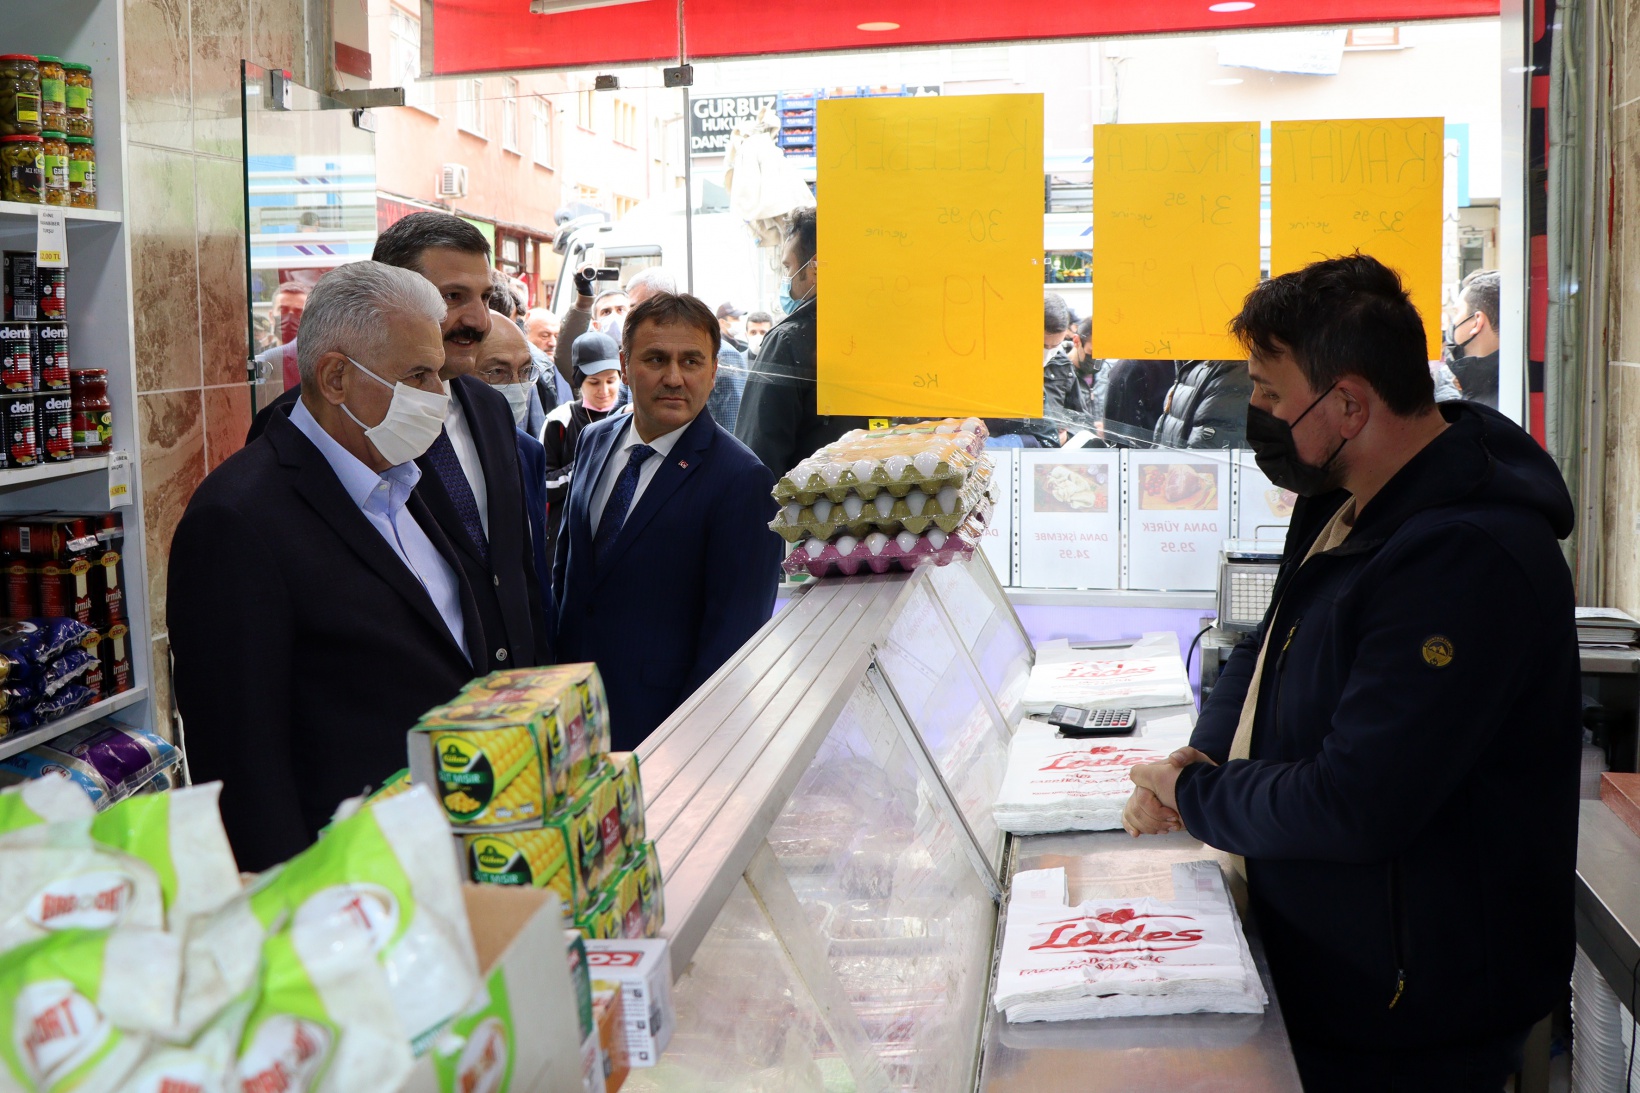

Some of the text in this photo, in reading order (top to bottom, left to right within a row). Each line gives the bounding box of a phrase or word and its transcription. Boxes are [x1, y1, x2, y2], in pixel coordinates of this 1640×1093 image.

[106, 588, 122, 603] irmik
[75, 597, 92, 612] irmik
[113, 660, 130, 675] irmik
[86, 670, 103, 685] irmik
[1038, 753, 1168, 771] Lades
[1028, 923, 1205, 951] Lades
